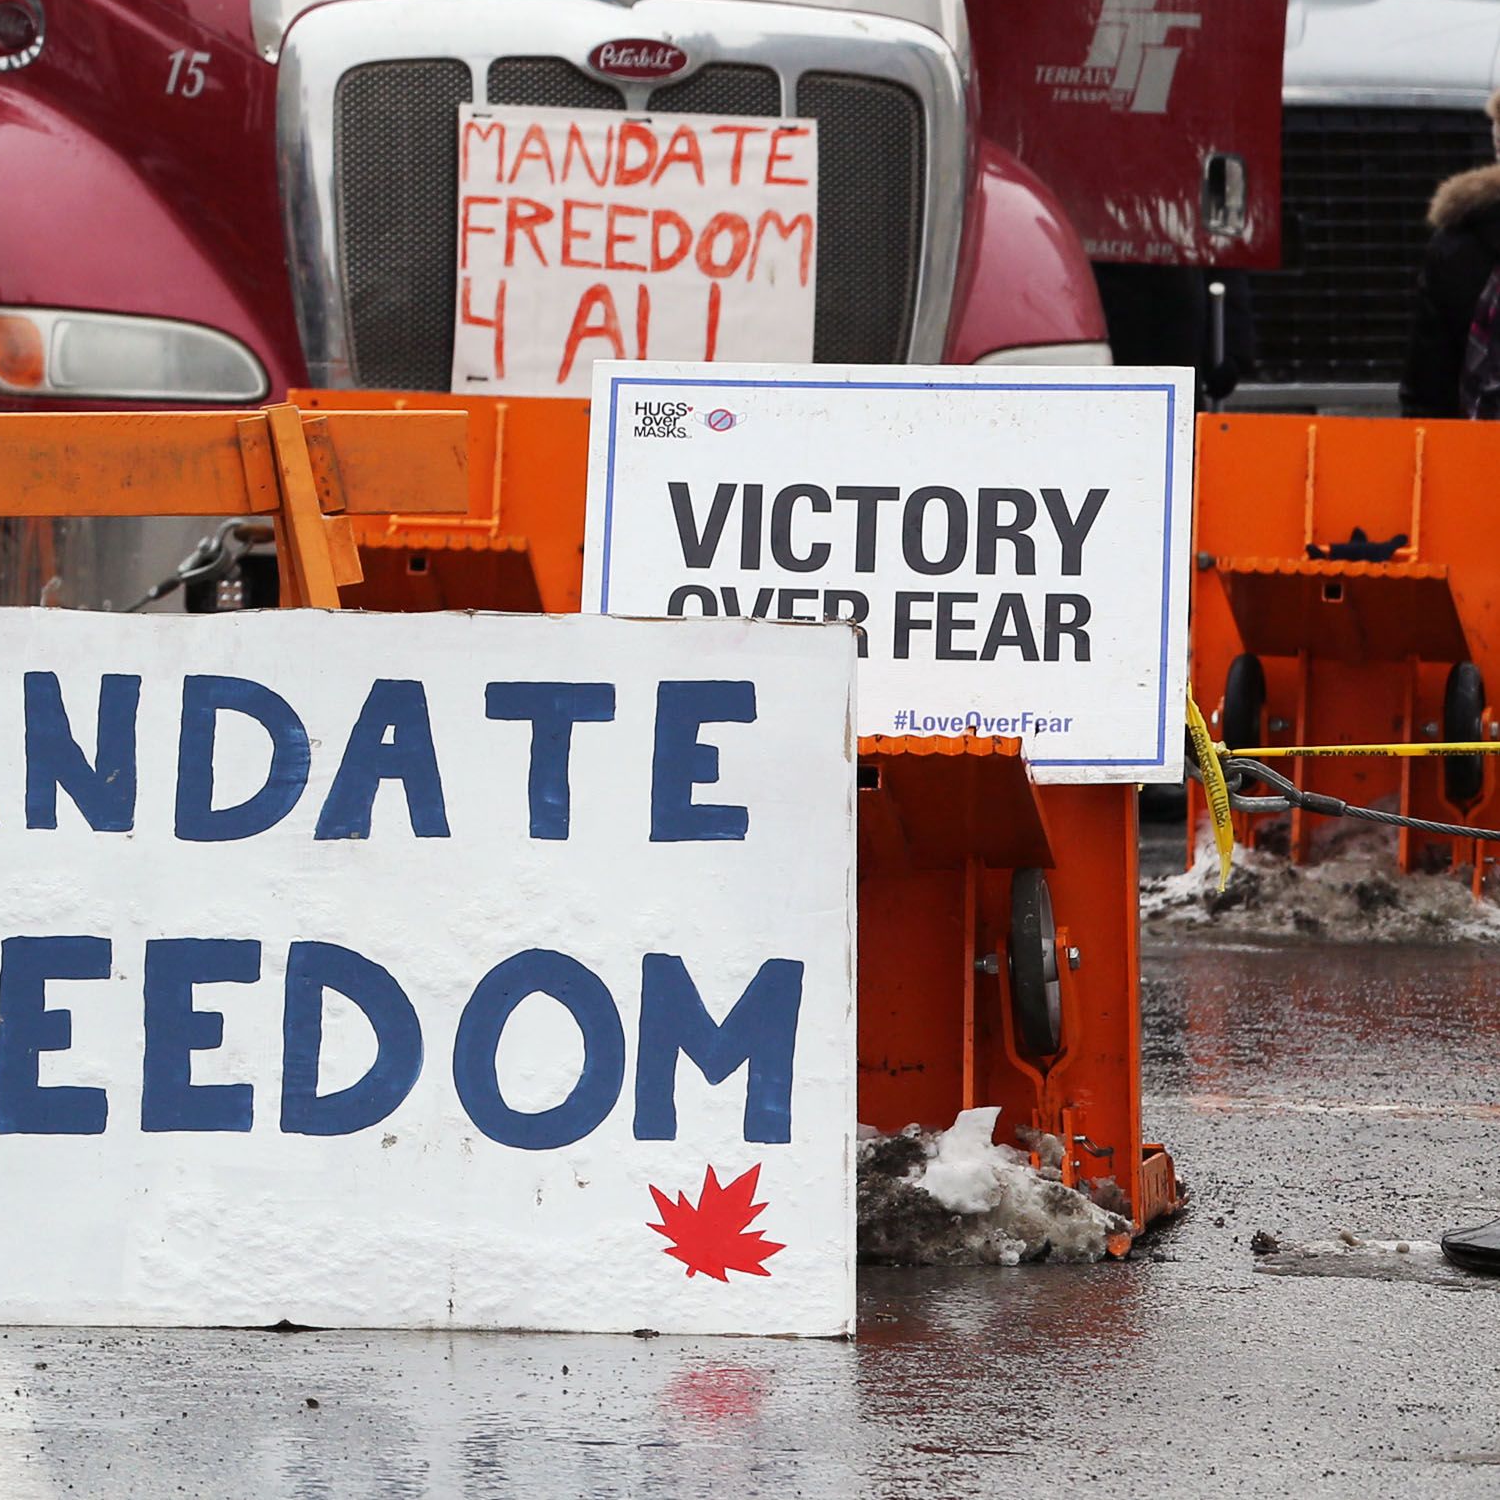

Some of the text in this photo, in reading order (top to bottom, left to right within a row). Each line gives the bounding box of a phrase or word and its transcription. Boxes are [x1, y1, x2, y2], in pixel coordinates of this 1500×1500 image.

[165, 48, 212, 101] 15
[599, 43, 679, 69] Peterbilt
[461, 121, 811, 190] MANDATE
[460, 196, 814, 287] FREEDOM
[462, 279, 506, 379] 4
[633, 425, 688, 439] MASKS
[634, 401, 688, 417] HUGS
[641, 415, 681, 427] over
[667, 482, 1110, 577] VICTORY
[893, 591, 1093, 662] FEAR
[893, 710, 1073, 735] #LoveOverFear
